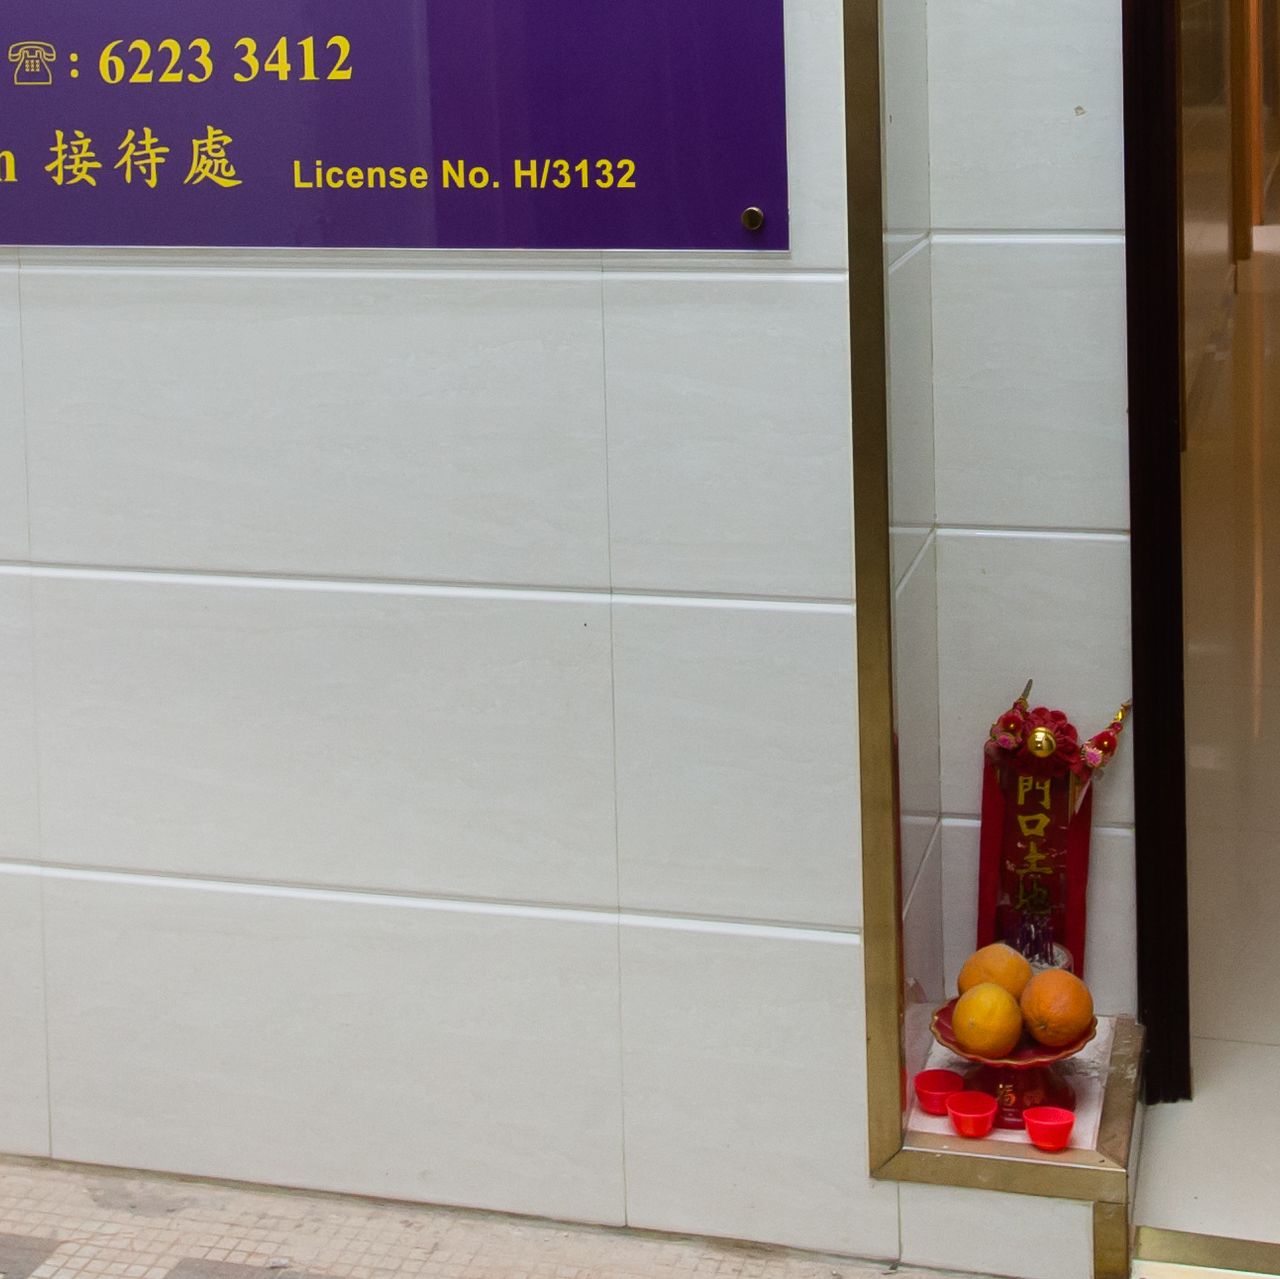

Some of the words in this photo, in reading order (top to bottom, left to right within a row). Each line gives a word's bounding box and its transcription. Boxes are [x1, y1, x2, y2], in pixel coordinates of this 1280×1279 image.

[98, 38, 213, 84] 6223
[233, 35, 353, 82] 3412
[45, 125, 241, 189] 接待處
[293, 160, 428, 189] License
[442, 159, 500, 189] No.
[514, 159, 636, 189] H/3132
